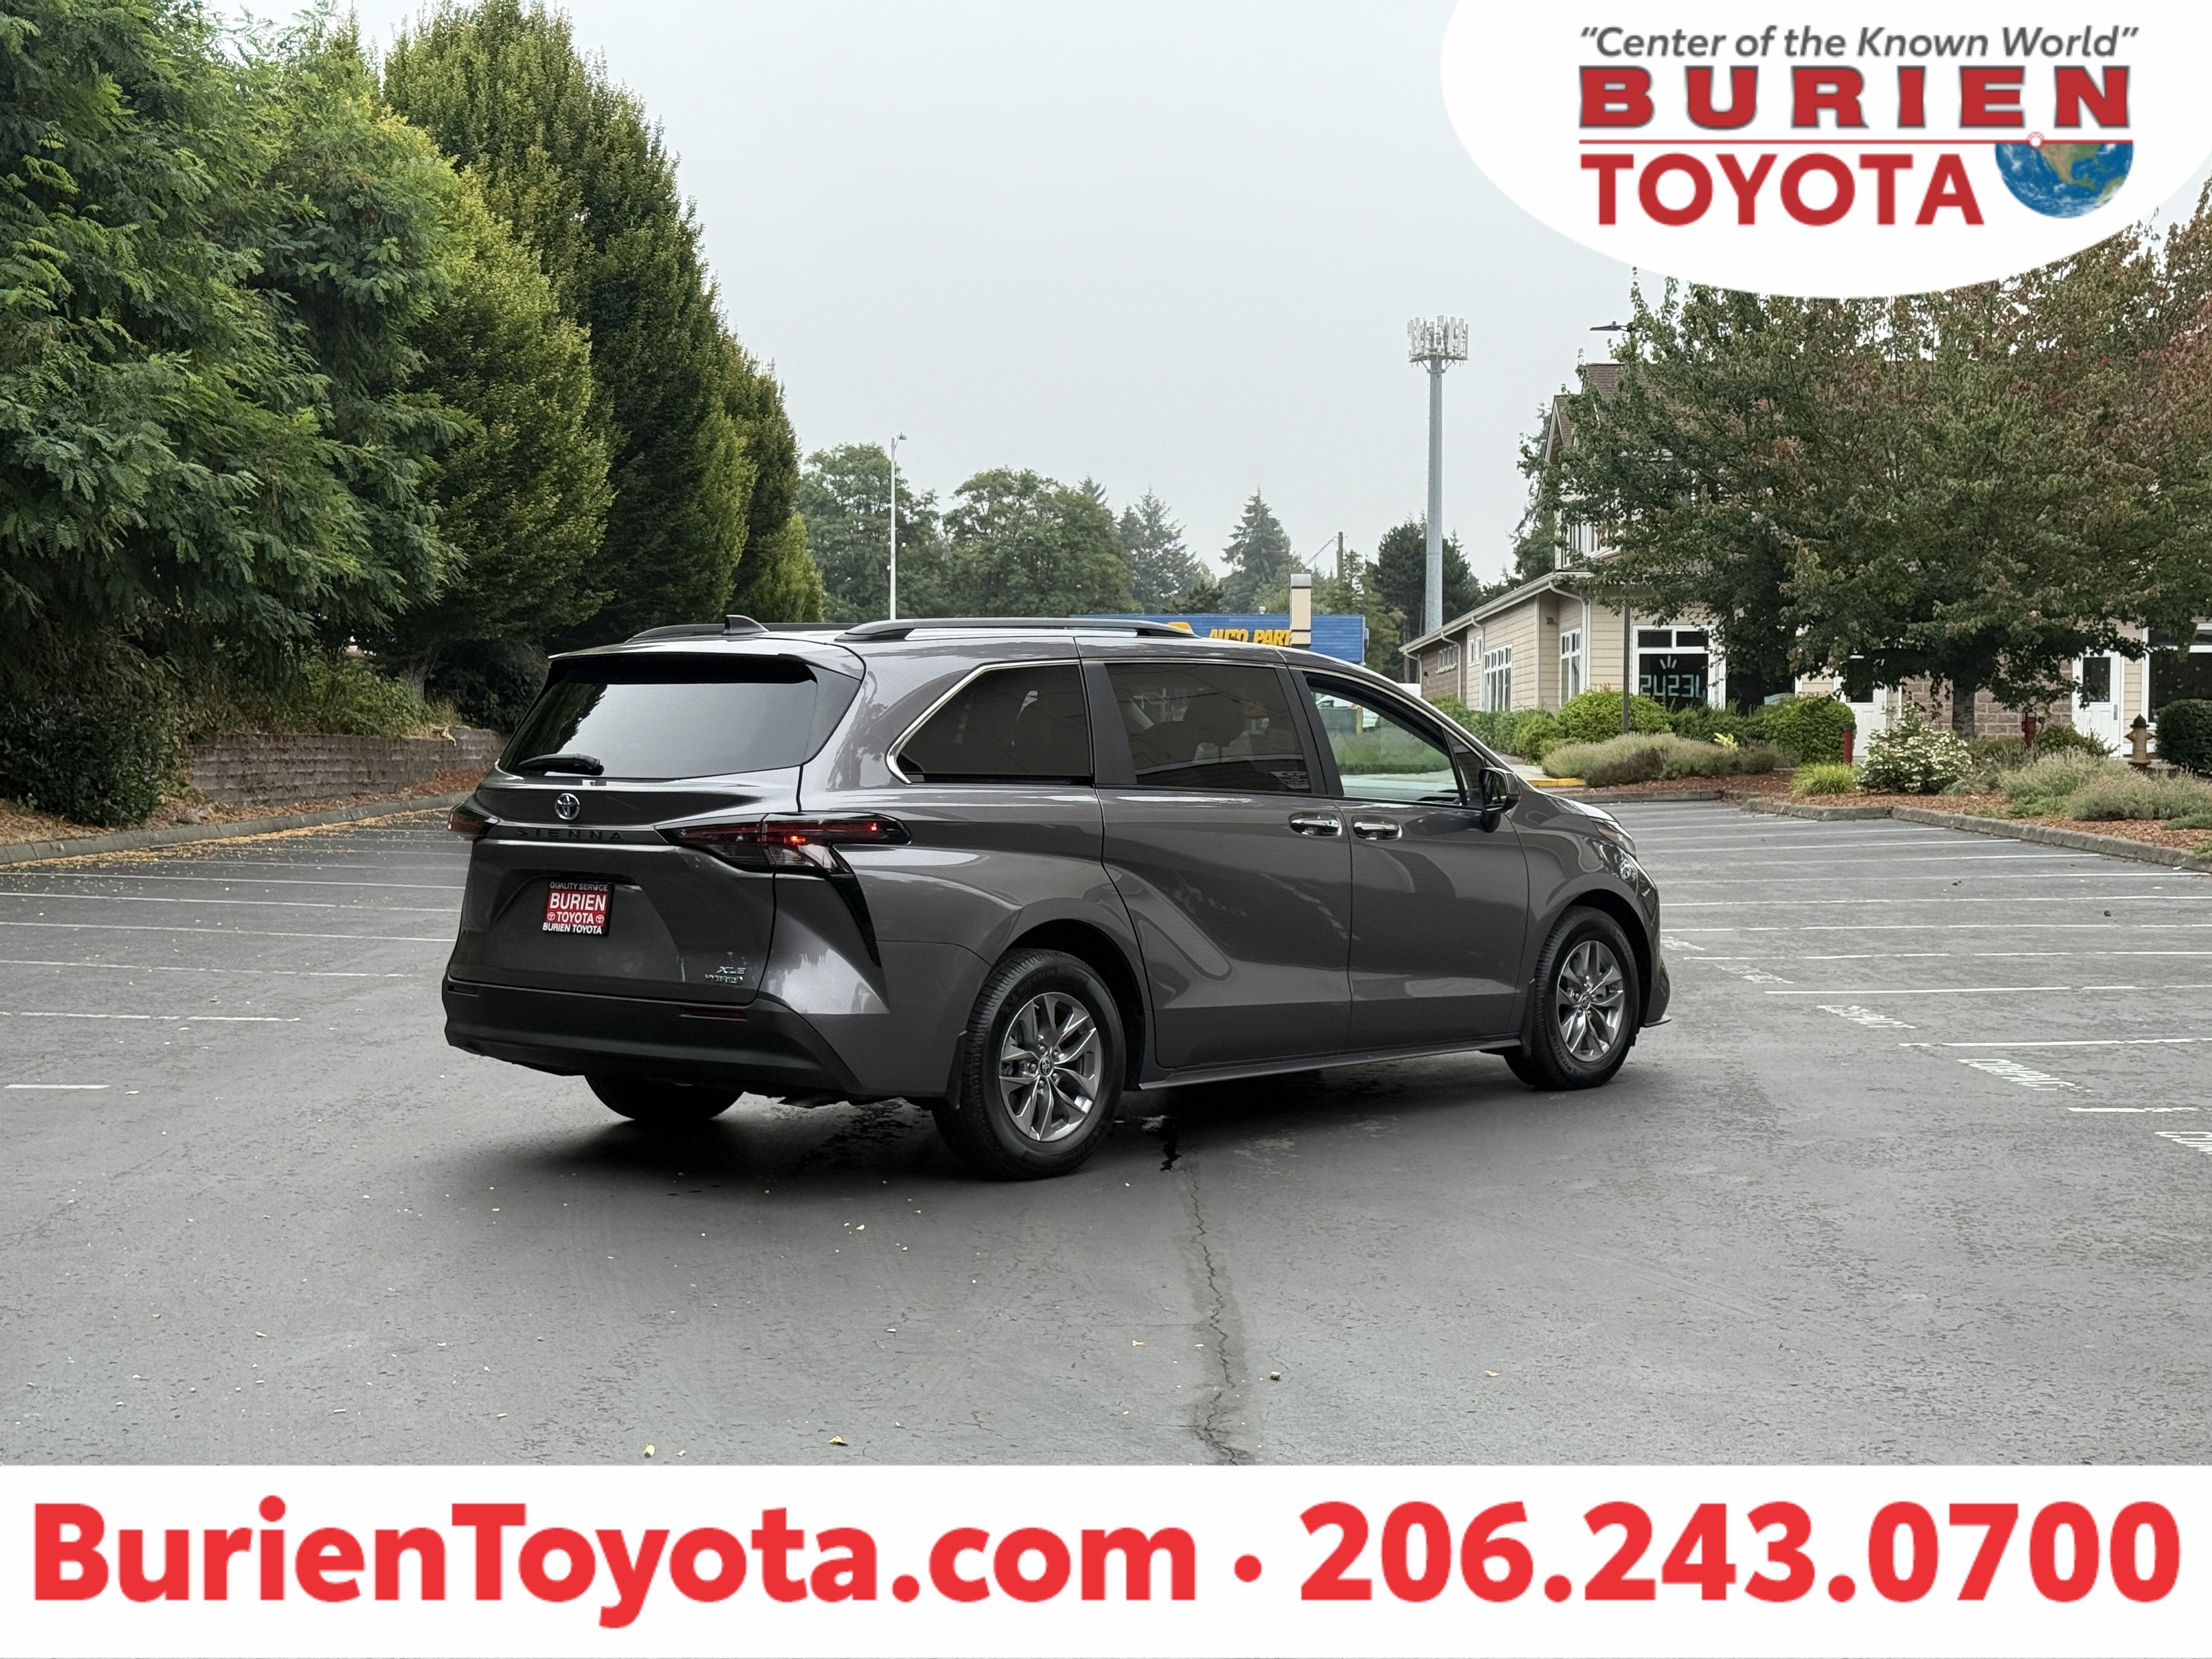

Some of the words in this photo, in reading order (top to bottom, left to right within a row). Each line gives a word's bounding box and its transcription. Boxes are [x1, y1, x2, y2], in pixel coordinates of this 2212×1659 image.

[1209, 629, 1249, 642] AUTO
[1253, 629, 1292, 646] PART
[517, 827, 624, 840] SIENNA
[550, 882, 578, 890] QUALITY
[579, 883, 608, 891] SERVICE
[550, 893, 606, 911] BURIEN
[557, 911, 594, 924] TOYOTA
[543, 922, 571, 933] BURIEN
[572, 924, 602, 934] TOYOTA
